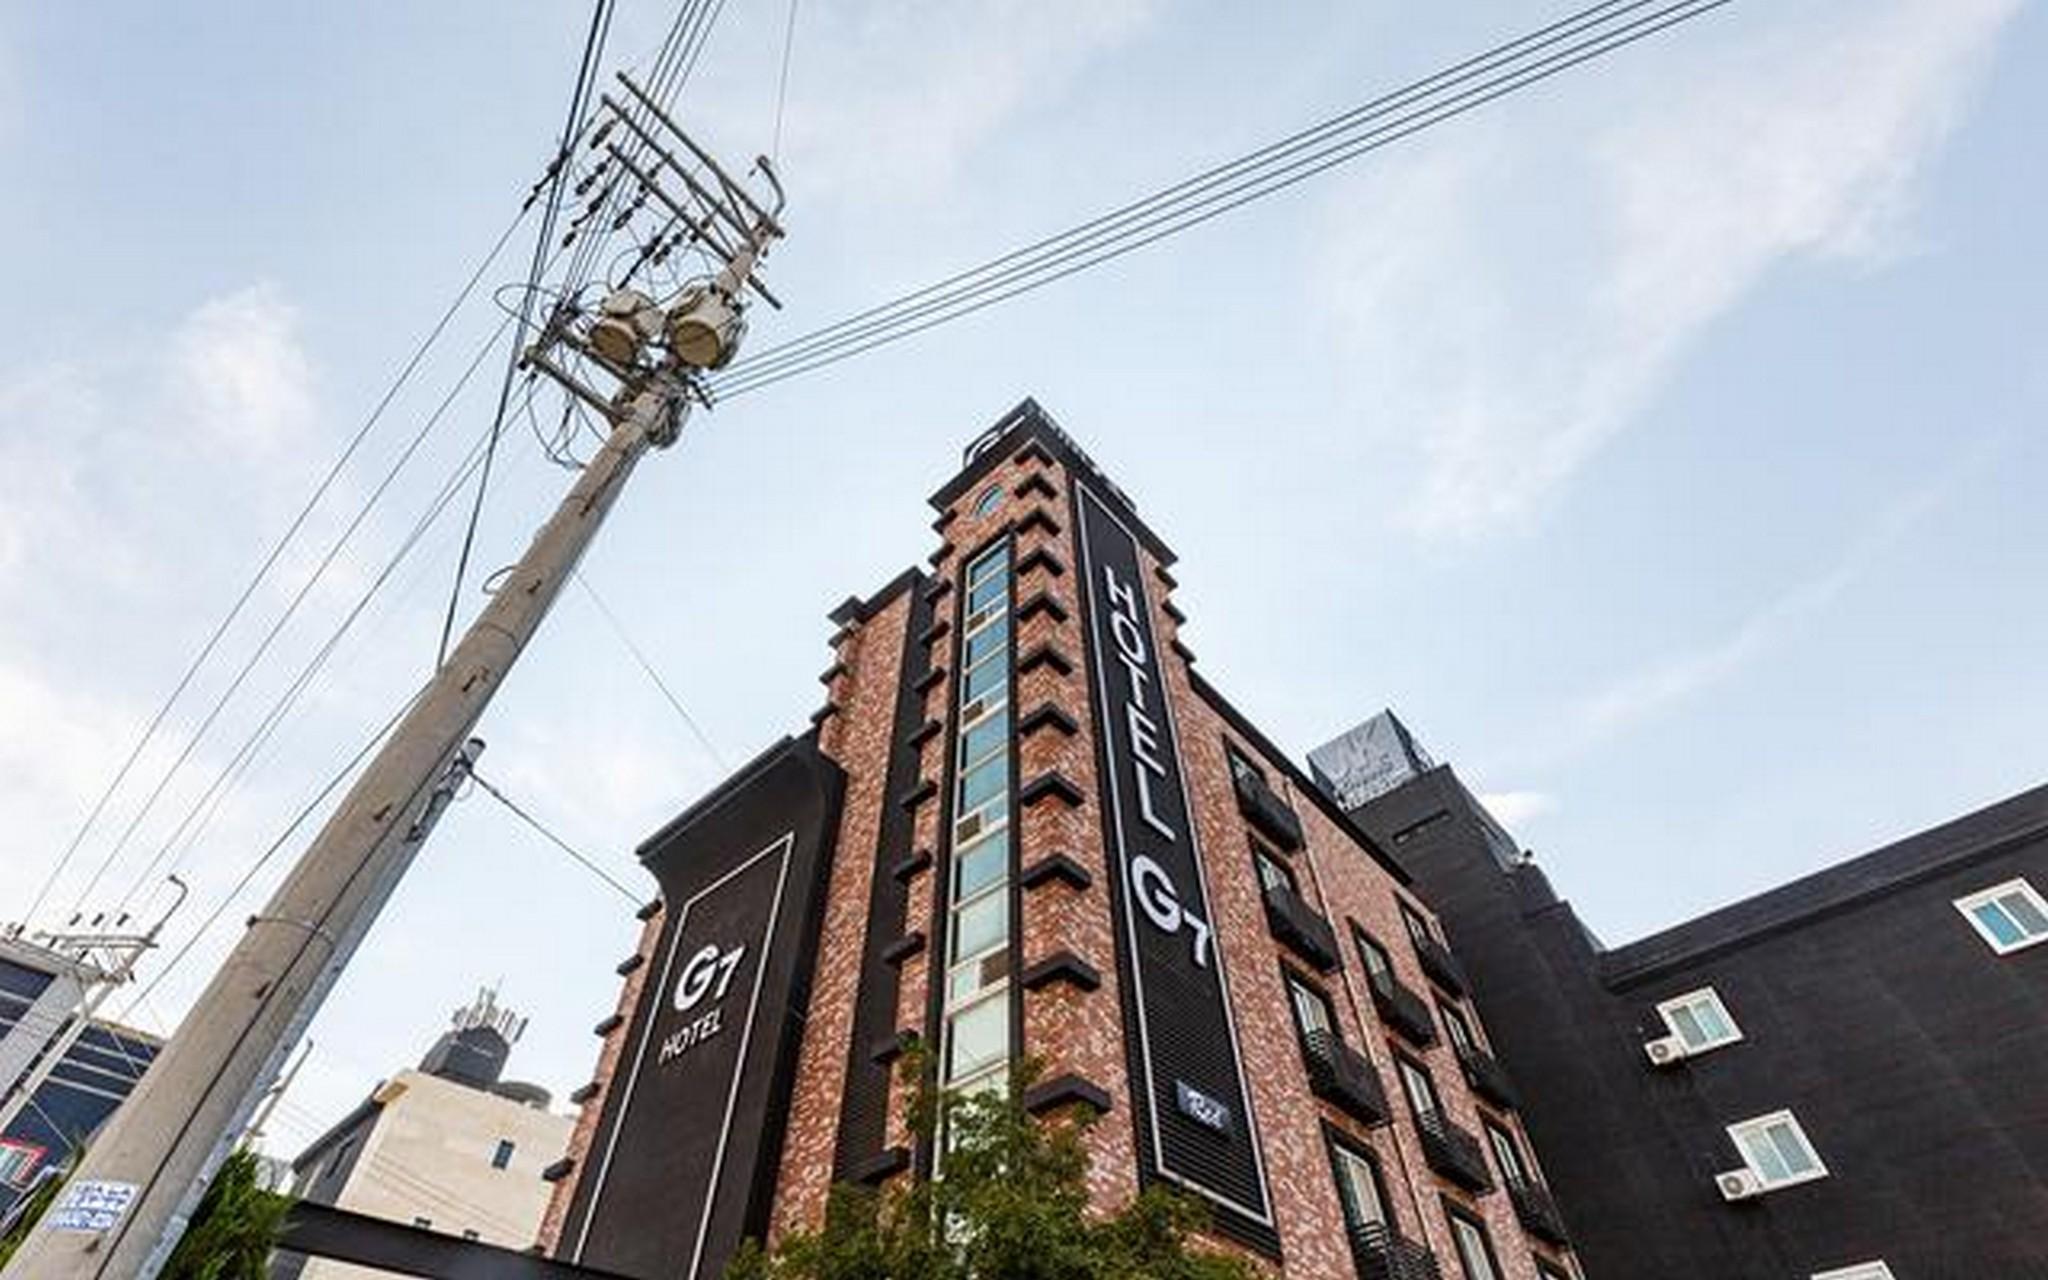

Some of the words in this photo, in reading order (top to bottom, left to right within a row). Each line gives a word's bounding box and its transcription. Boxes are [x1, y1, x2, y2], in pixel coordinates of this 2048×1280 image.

[1105, 565, 1176, 841] HOTEL
[1131, 854, 1208, 969] G7
[674, 944, 746, 1012] G7
[658, 1008, 721, 1065] HOTEL
